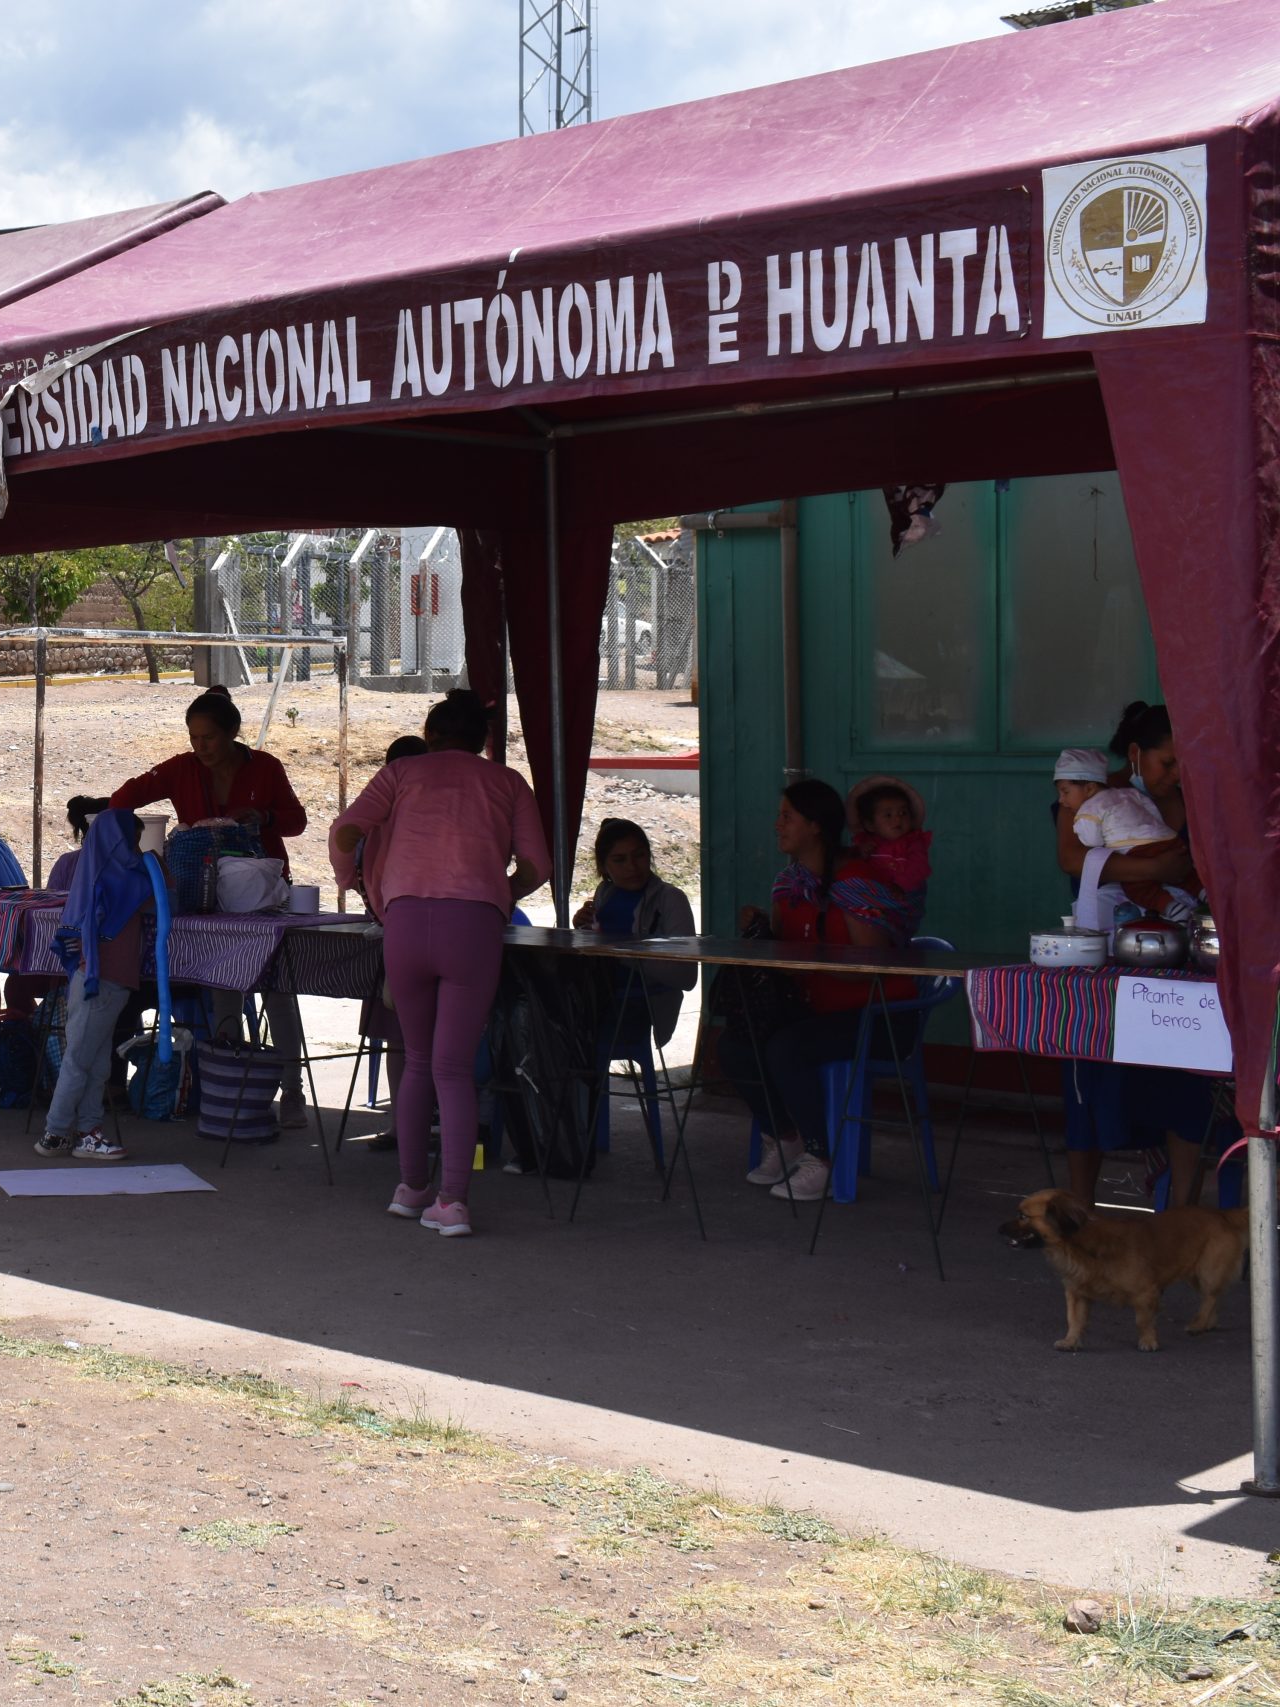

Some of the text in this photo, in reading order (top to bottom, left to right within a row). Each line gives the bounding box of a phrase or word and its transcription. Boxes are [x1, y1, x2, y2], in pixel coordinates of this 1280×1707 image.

[1052, 165, 1197, 256] UNIVERSIDAD NACIONAL AUTÓNOMA DE HUANTA
[161, 316, 371, 430] NACIONAL
[390, 247, 675, 400] AUTÓNOMA
[766, 224, 1020, 356] HUANTA
[1106, 310, 1142, 323] UNAH
[1132, 982, 1216, 1010] Picante de
[1151, 1009, 1202, 1031] berros
